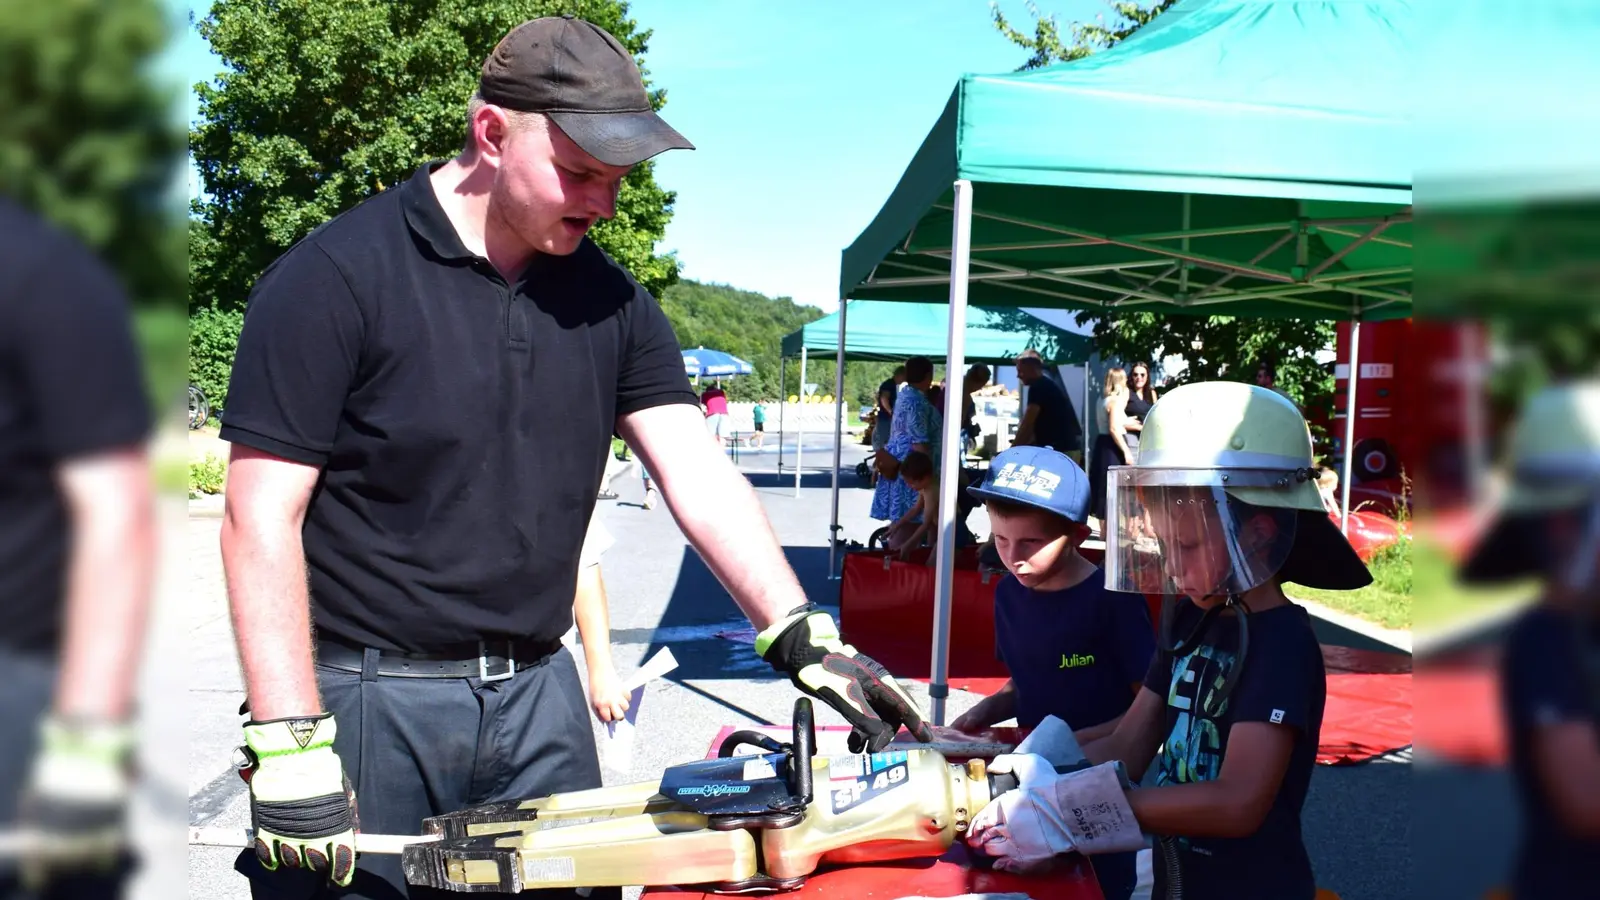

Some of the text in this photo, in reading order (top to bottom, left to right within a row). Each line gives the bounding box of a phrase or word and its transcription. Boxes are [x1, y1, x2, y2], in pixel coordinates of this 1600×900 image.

[1369, 365, 1388, 377] 112
[1059, 653, 1095, 668] Julian
[834, 765, 906, 809] SP 49
